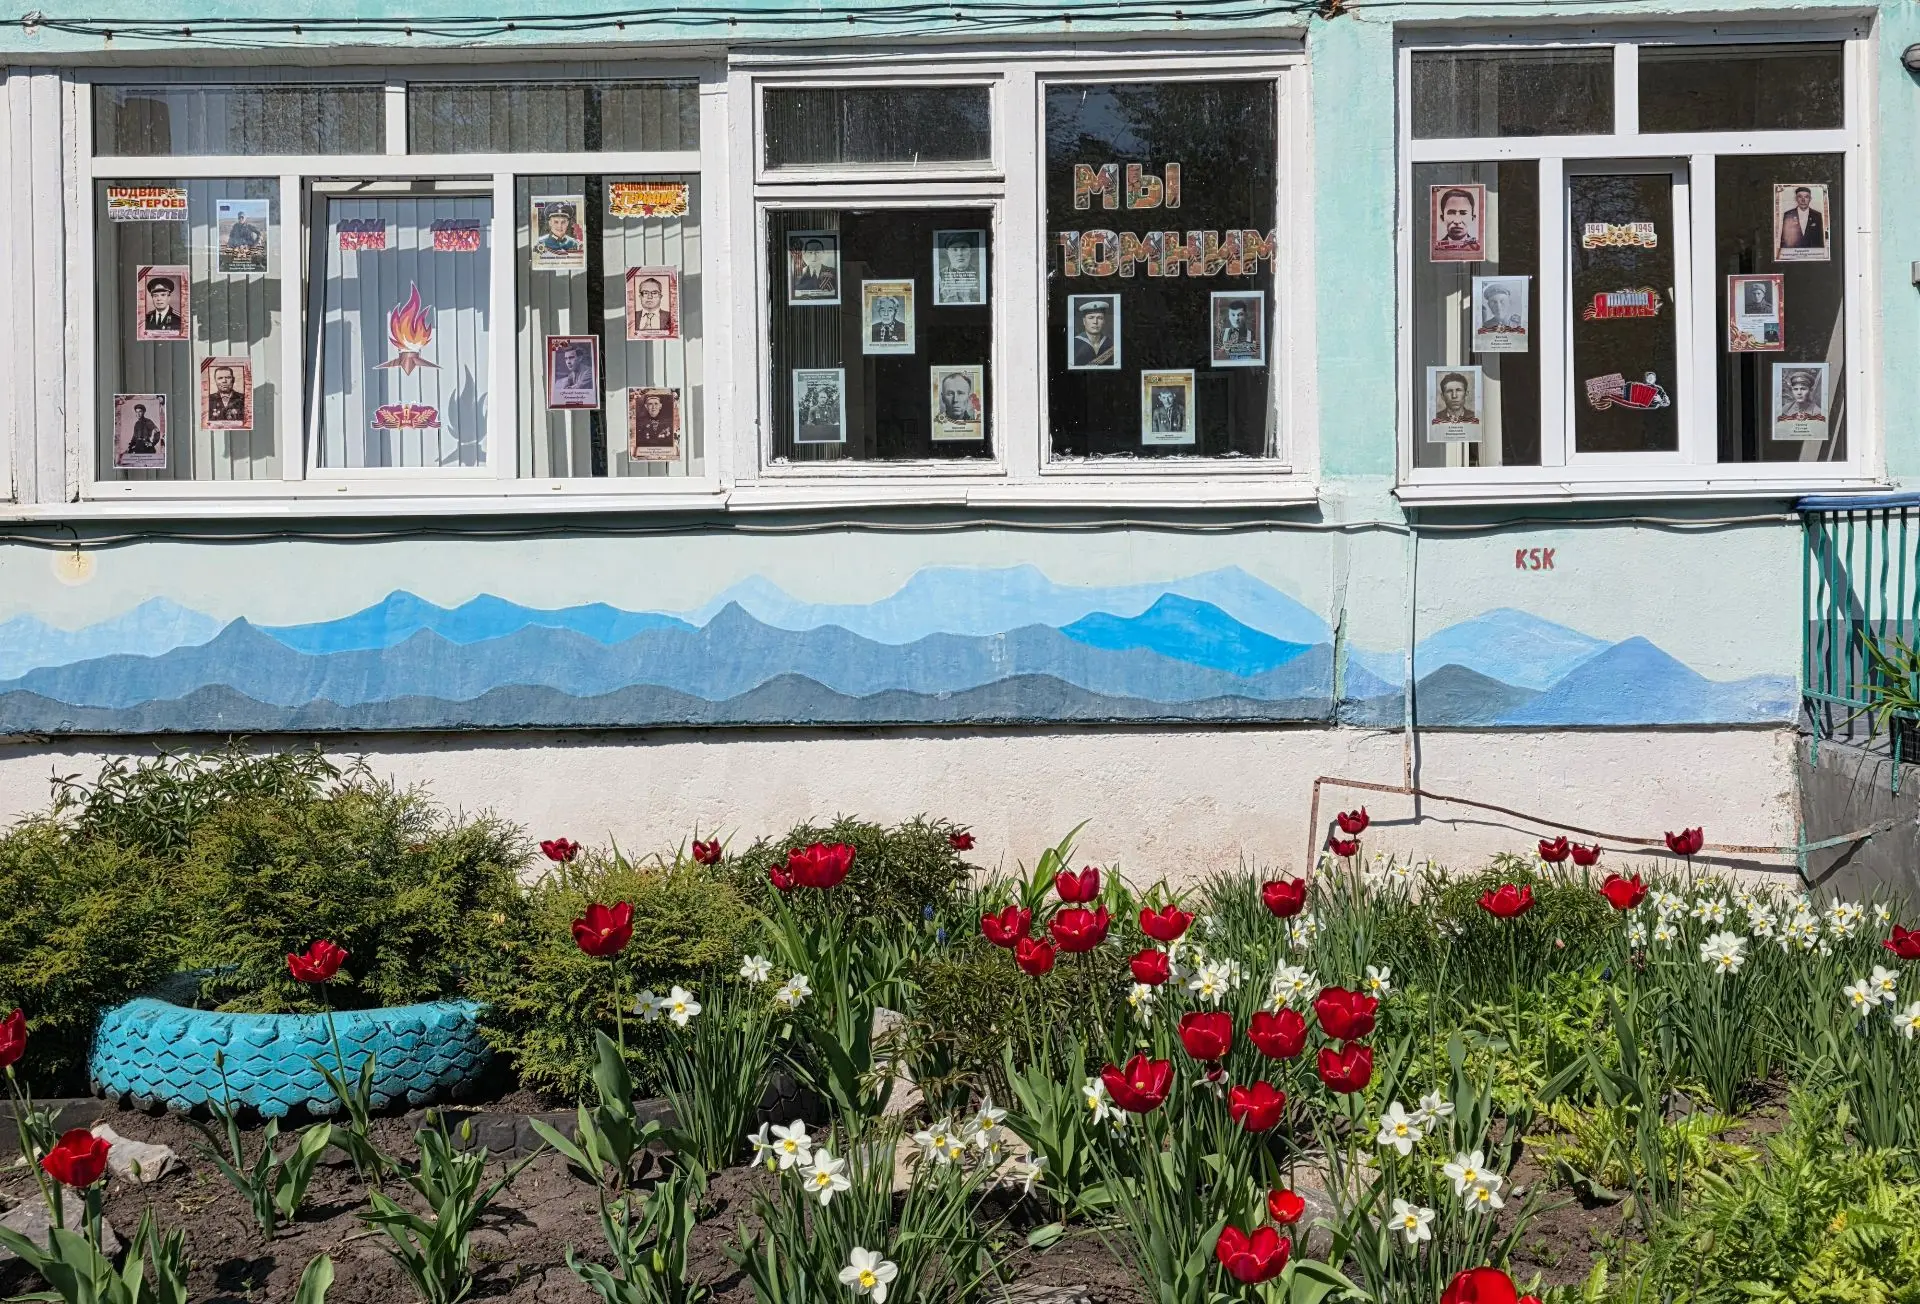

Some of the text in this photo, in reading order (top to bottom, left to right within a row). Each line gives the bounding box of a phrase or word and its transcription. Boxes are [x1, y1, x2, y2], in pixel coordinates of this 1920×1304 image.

[1074, 163, 1180, 209] МЫ
[139, 199, 186, 208] ГЕРОЕВ
[1587, 224, 1604, 234] 1941
[1634, 223, 1652, 233] 1945
[1515, 547, 1556, 571] KSK
